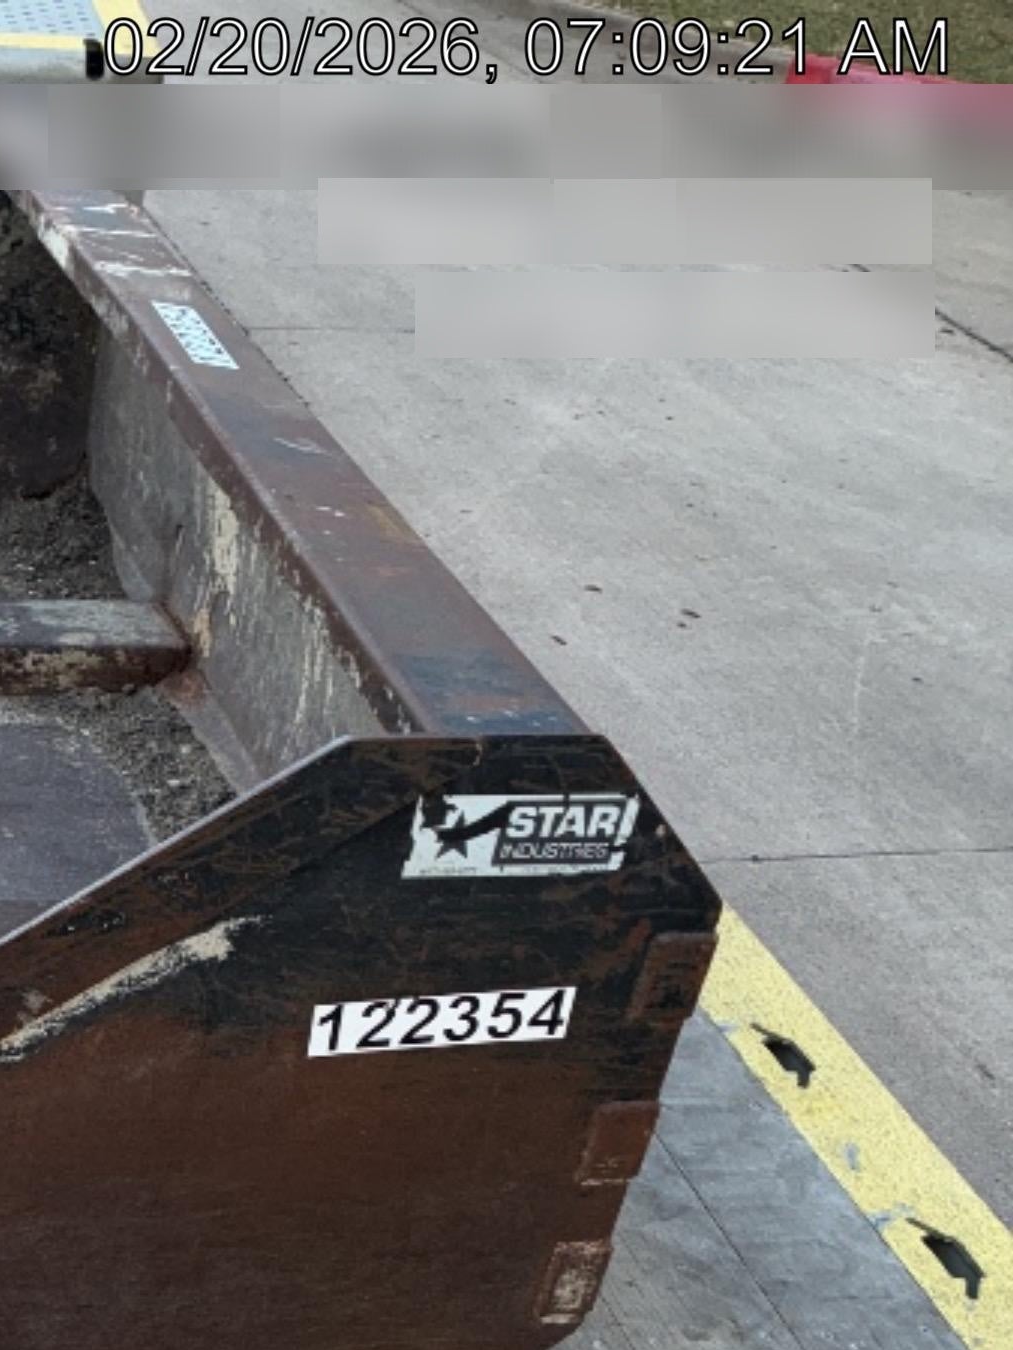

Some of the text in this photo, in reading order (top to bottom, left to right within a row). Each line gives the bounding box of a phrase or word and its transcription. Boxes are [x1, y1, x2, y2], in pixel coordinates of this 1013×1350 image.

[506, 805, 621, 838] STAR
[499, 842, 609, 860] INDUSTRIES
[317, 989, 566, 1051] 122354
